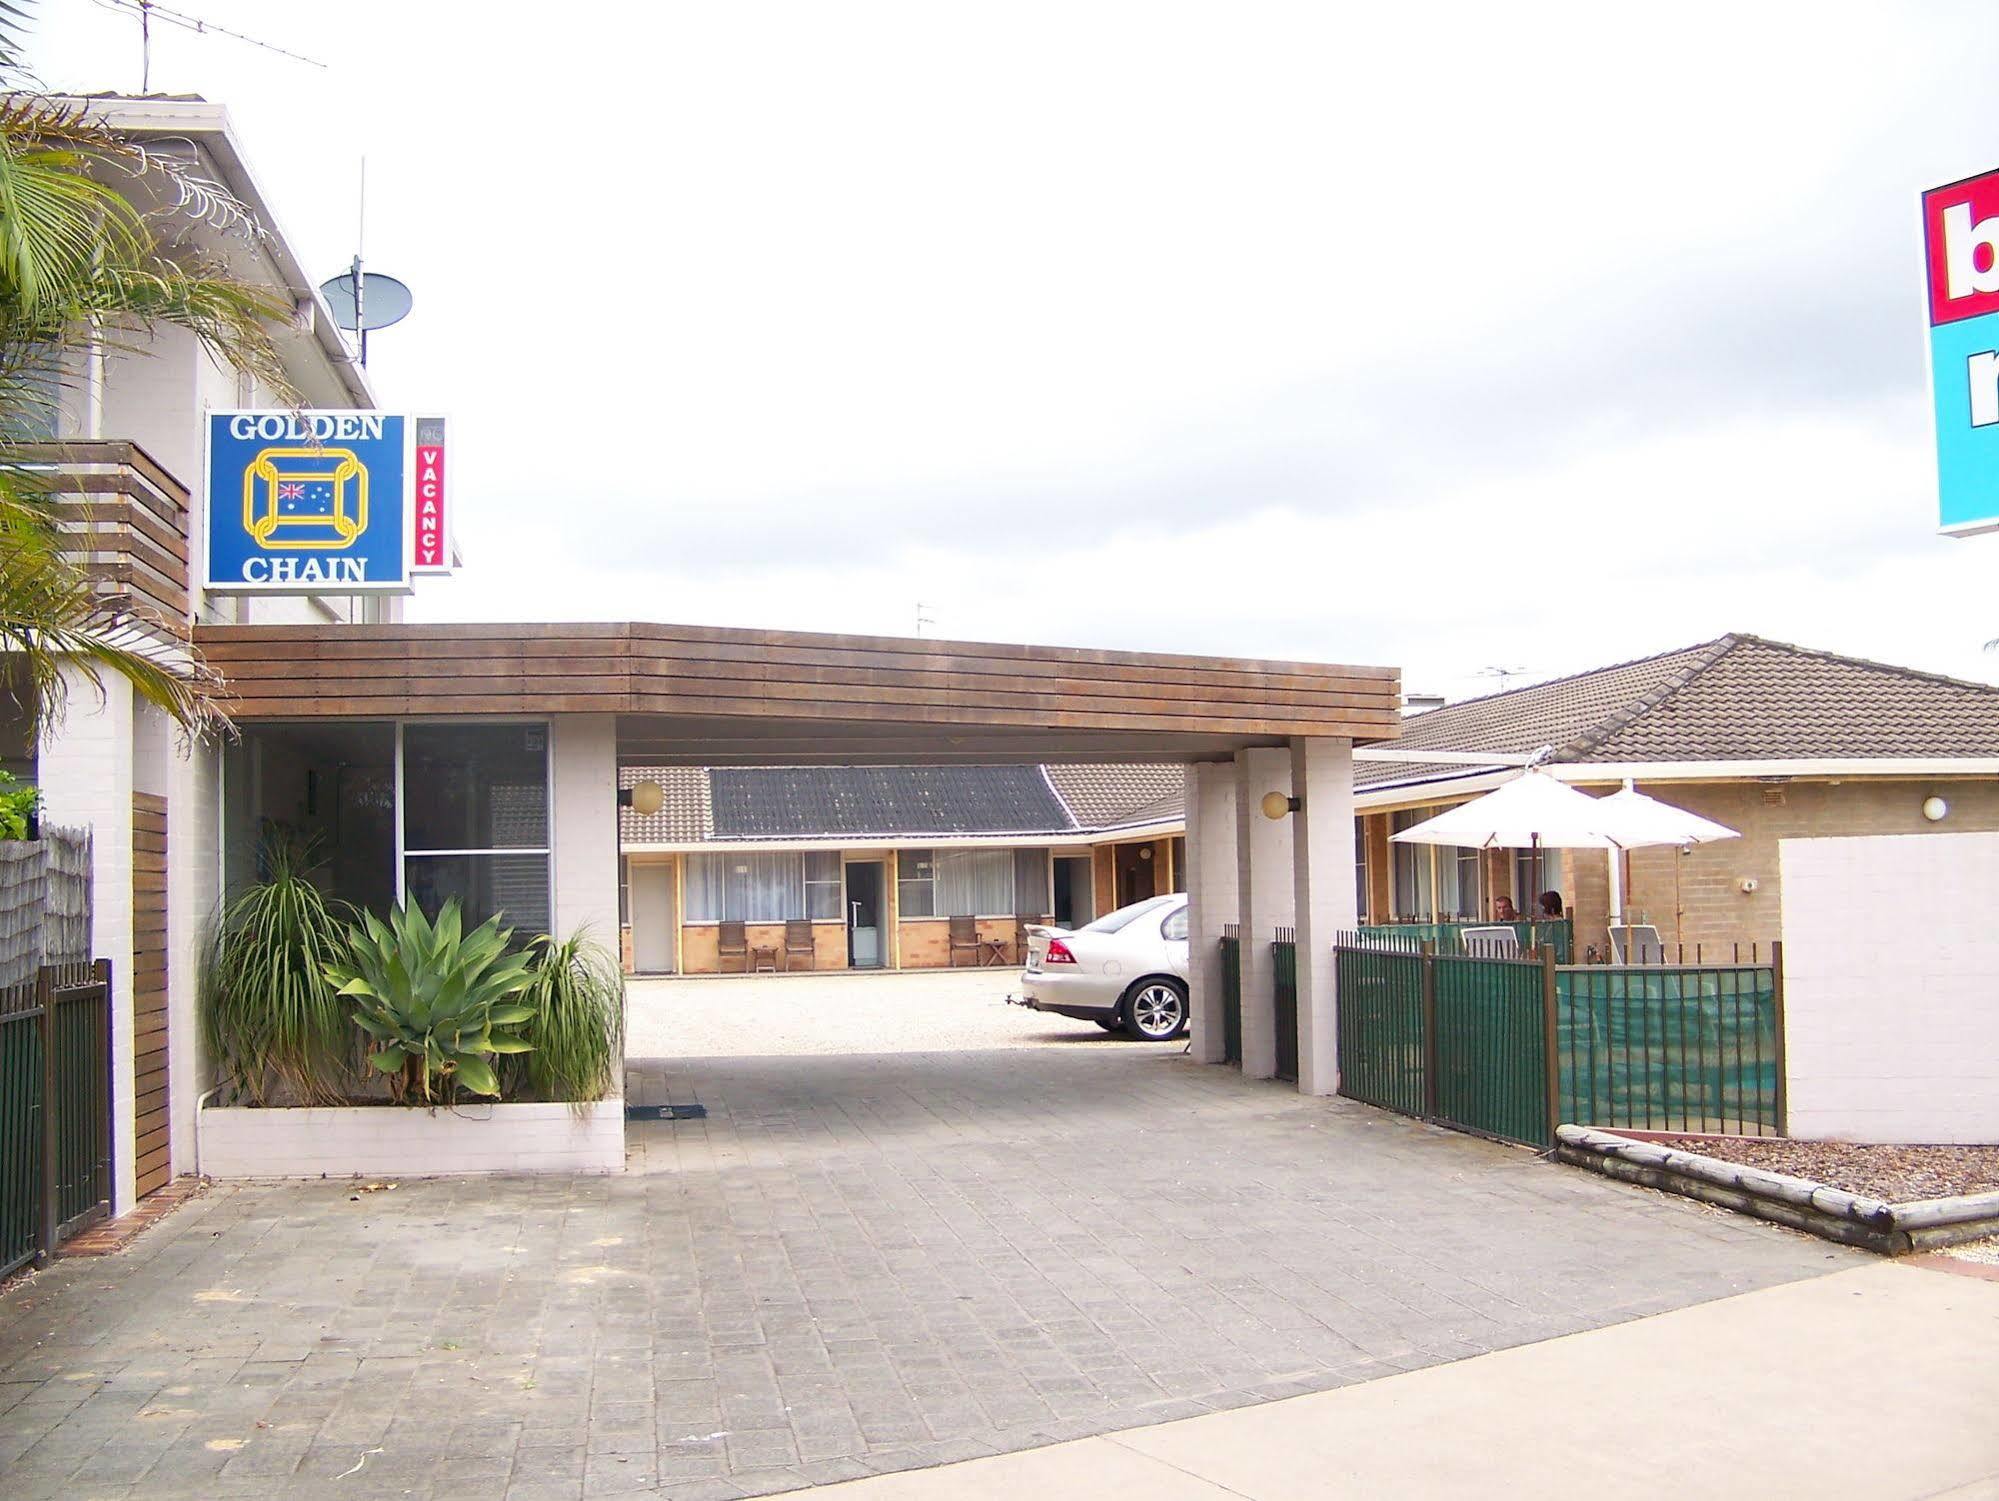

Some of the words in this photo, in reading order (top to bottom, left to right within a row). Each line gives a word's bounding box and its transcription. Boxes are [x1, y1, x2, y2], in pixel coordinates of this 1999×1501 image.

[229, 415, 386, 440] GOLDEN
[422, 451, 439, 564] VACANCY
[242, 557, 369, 582] CHAIN
